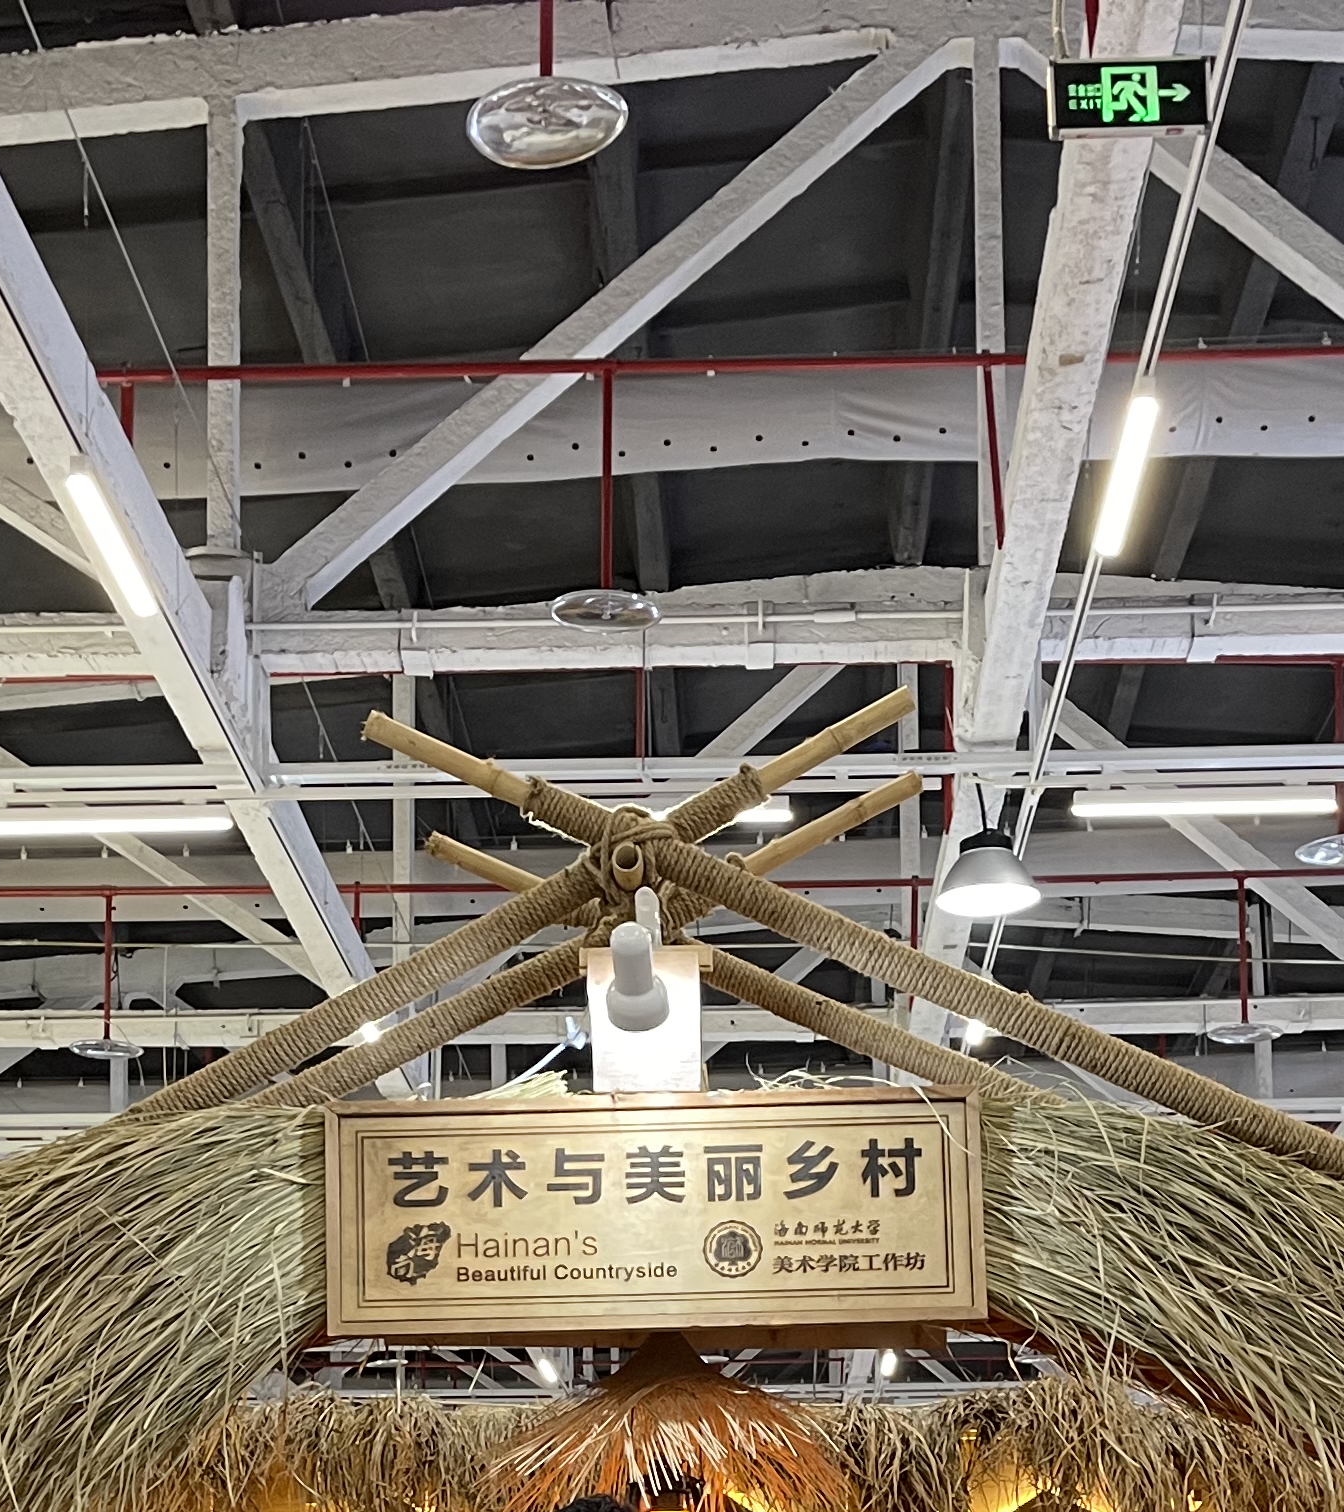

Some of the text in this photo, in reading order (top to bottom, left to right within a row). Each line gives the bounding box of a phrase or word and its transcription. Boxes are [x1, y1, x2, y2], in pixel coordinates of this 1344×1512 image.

[388, 1137, 923, 1208] 艺术与美丽乡村
[774, 1219, 881, 1238] 海南师范大学
[456, 1230, 599, 1259] Hainan's
[457, 1262, 678, 1283] Beautiful Countryside
[772, 1252, 926, 1275] 美术学院工作坊
